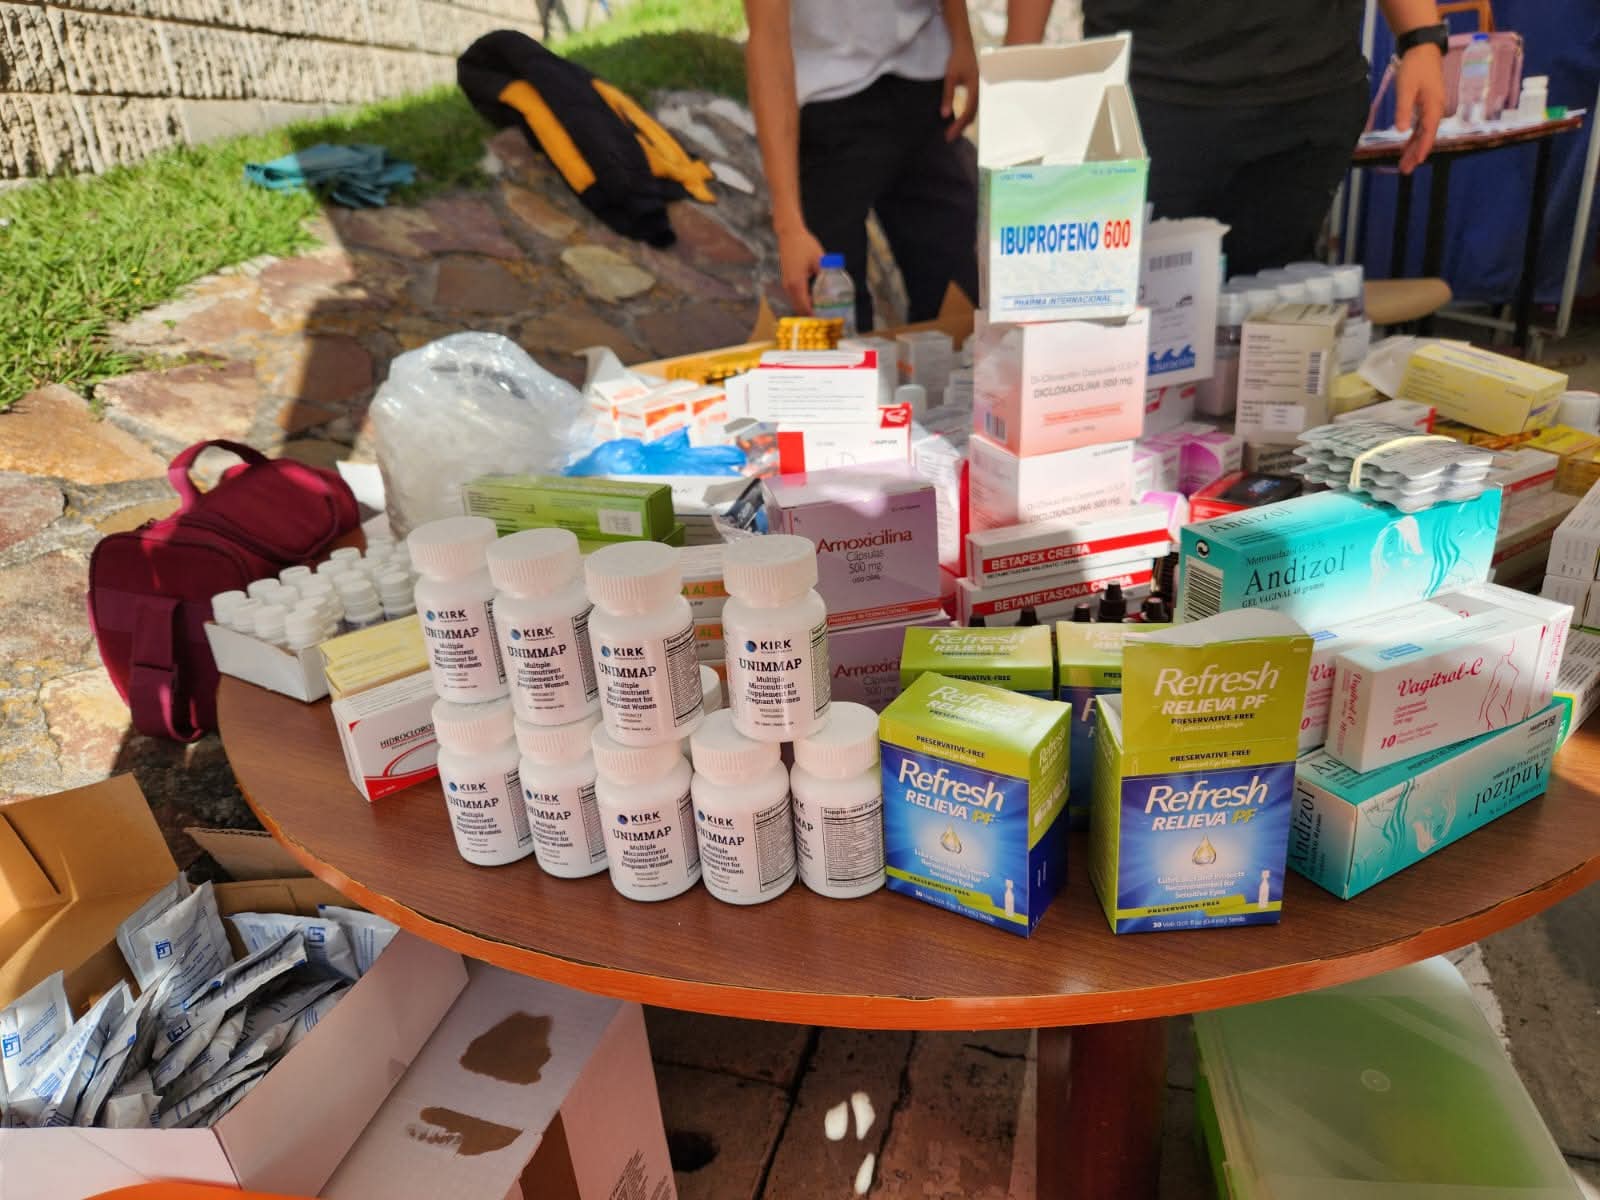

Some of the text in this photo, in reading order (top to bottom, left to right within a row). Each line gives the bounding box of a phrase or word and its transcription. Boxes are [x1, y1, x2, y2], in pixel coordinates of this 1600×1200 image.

[1000, 219, 1131, 255] IBUPROFENO 600
[1014, 295, 1111, 306] PHARMA INTERNACIONAL
[1033, 381, 1099, 399] DICLOXACILINA
[1208, 507, 1293, 534] Andizol
[815, 528, 912, 555] Amoxicilina
[991, 544, 1090, 571] BETAPEX CREMA
[849, 562, 866, 575] 500
[1244, 545, 1347, 596] Andizol
[994, 584, 1089, 612] BETAMETASONA
[438, 609, 467, 619] KIRK
[424, 626, 480, 640] UNIMMAP
[523, 627, 554, 638] KIRK
[506, 643, 567, 659] UNIMMAP
[613, 647, 644, 656] KIRK
[760, 639, 792, 650] KIRK
[598, 661, 657, 678] UNIMMAP
[738, 657, 802, 672] UNIMMAP
[833, 657, 903, 678] Amoxici
[756, 675, 785, 684] Multiple
[1154, 660, 1280, 697] Refresh
[1398, 656, 1484, 698] Vagitrol-C
[631, 703, 657, 711] Women
[1161, 694, 1267, 716] RELIEVA PF
[1171, 713, 1255, 726] PRESERVATIVE-FREE
[379, 723, 435, 749] HIDROCLORO
[1380, 734, 1397, 750] 10
[916, 735, 986, 758] PRESERVATIVE-FREE
[1170, 750, 1250, 762] PRESERVATIVE-FREE
[459, 782, 487, 791] KIRK
[898, 758, 1004, 811] Refresh
[534, 794, 560, 803] KIRK
[1144, 775, 1268, 814] Refresh
[824, 803, 864, 815] Supplement
[906, 789, 993, 825] RELIEVA PF
[630, 810, 661, 823] KIRK
[707, 814, 734, 826] KIRK
[1152, 808, 1257, 831] RELIEVA PF
[612, 825, 672, 841] UNIMMAP
[1152, 921, 1163, 929] 30
